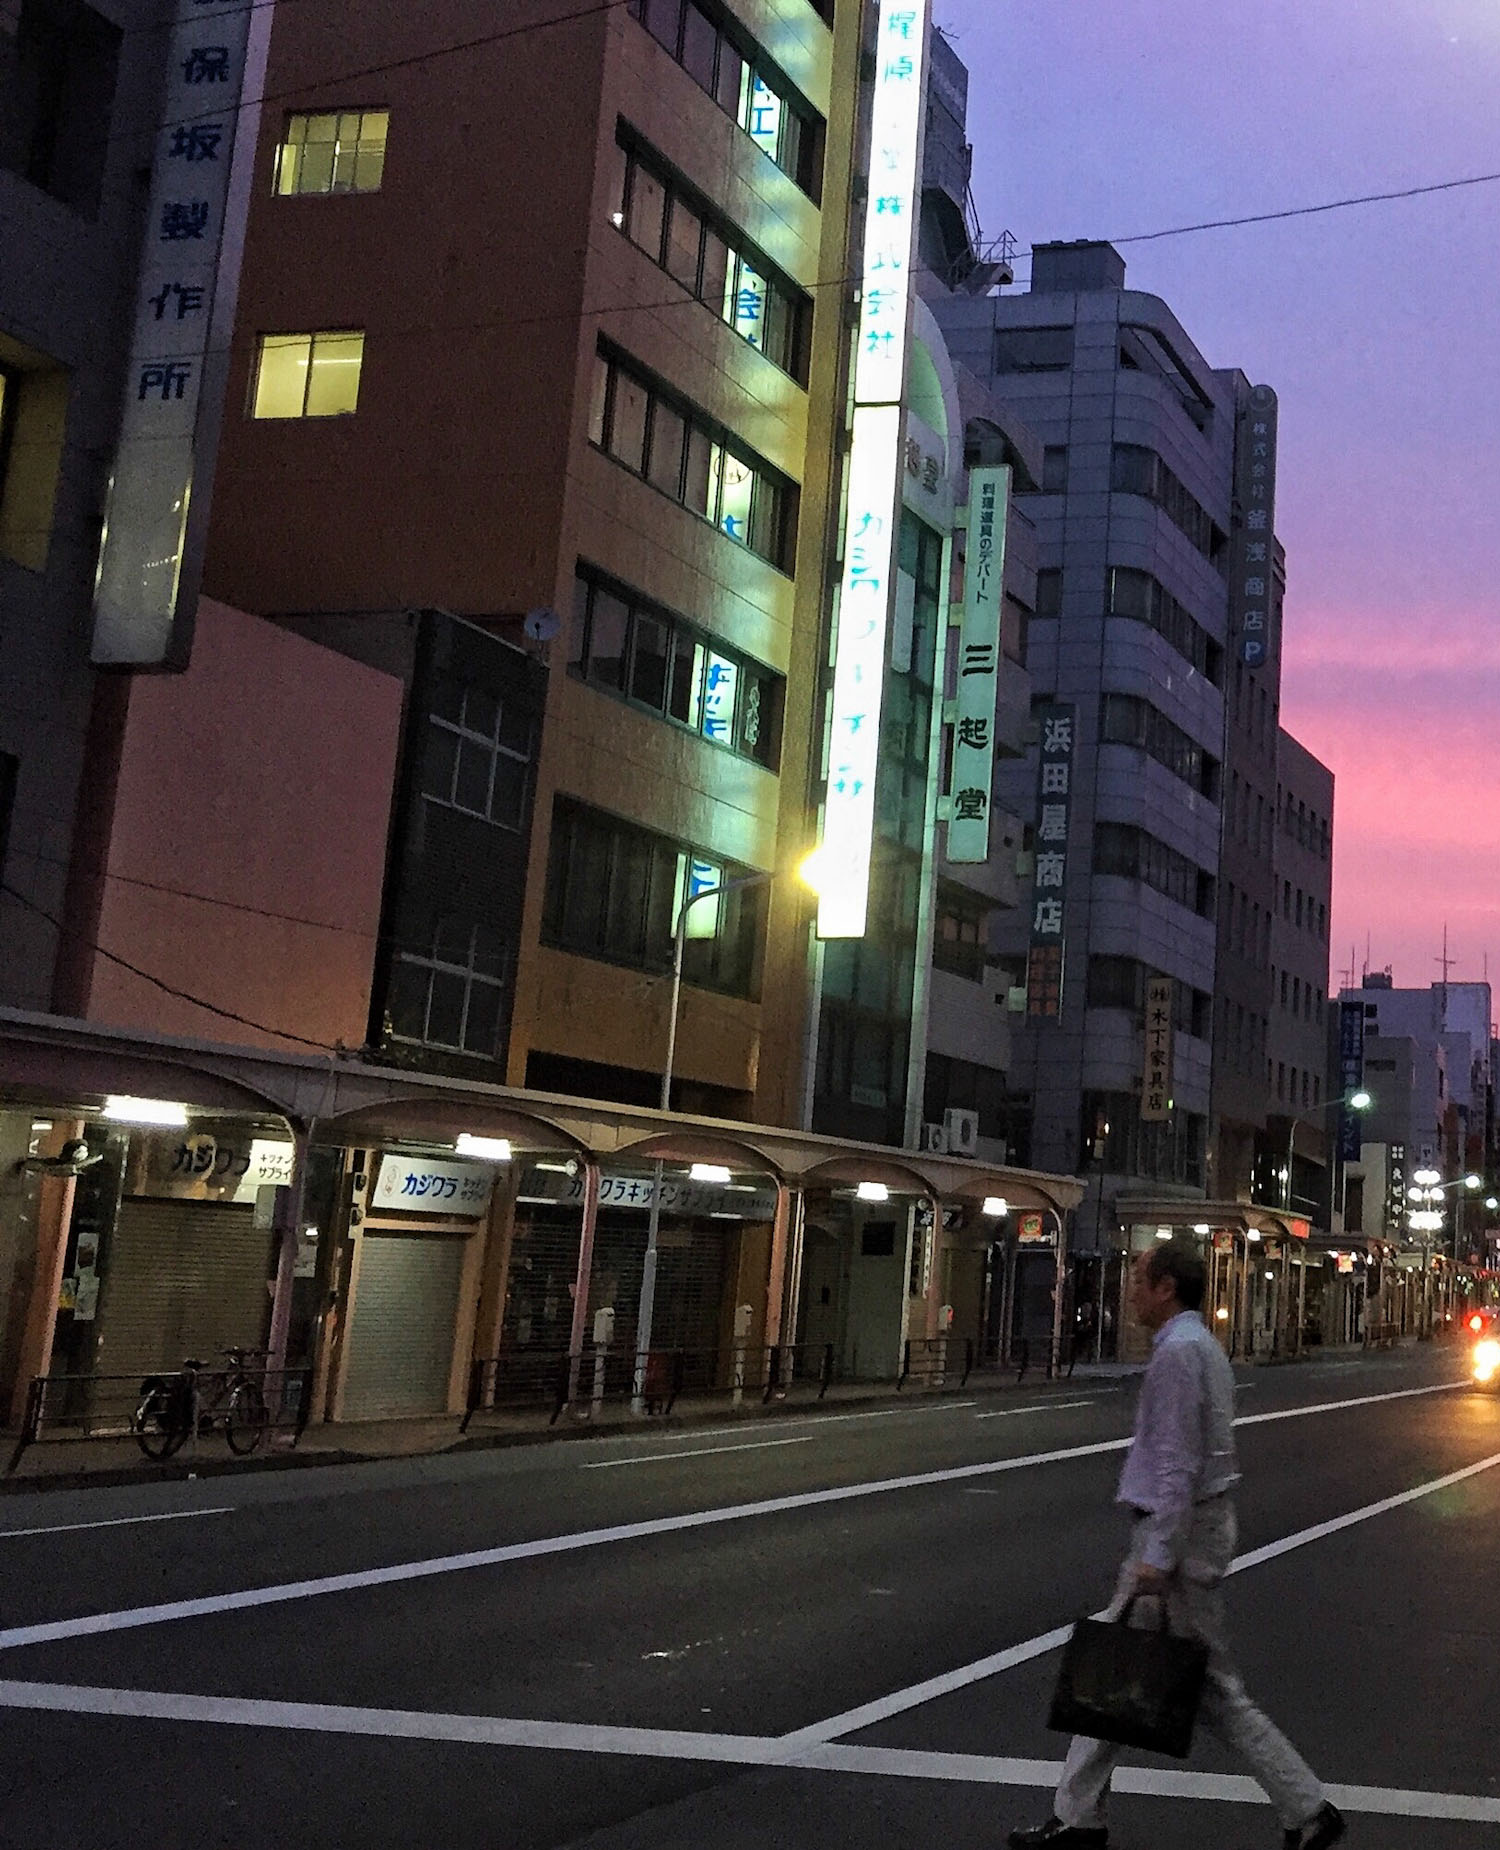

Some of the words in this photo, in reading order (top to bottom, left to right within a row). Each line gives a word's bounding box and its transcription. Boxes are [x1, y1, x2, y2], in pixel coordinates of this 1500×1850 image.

[137, 46, 231, 401] 保坂製作所
[976, 483, 996, 604] 料理道具のデパート
[955, 643, 994, 822] 三起堂
[1034, 716, 1073, 935] 浜田屋商店
[400, 1172, 459, 1199] カジワラ
